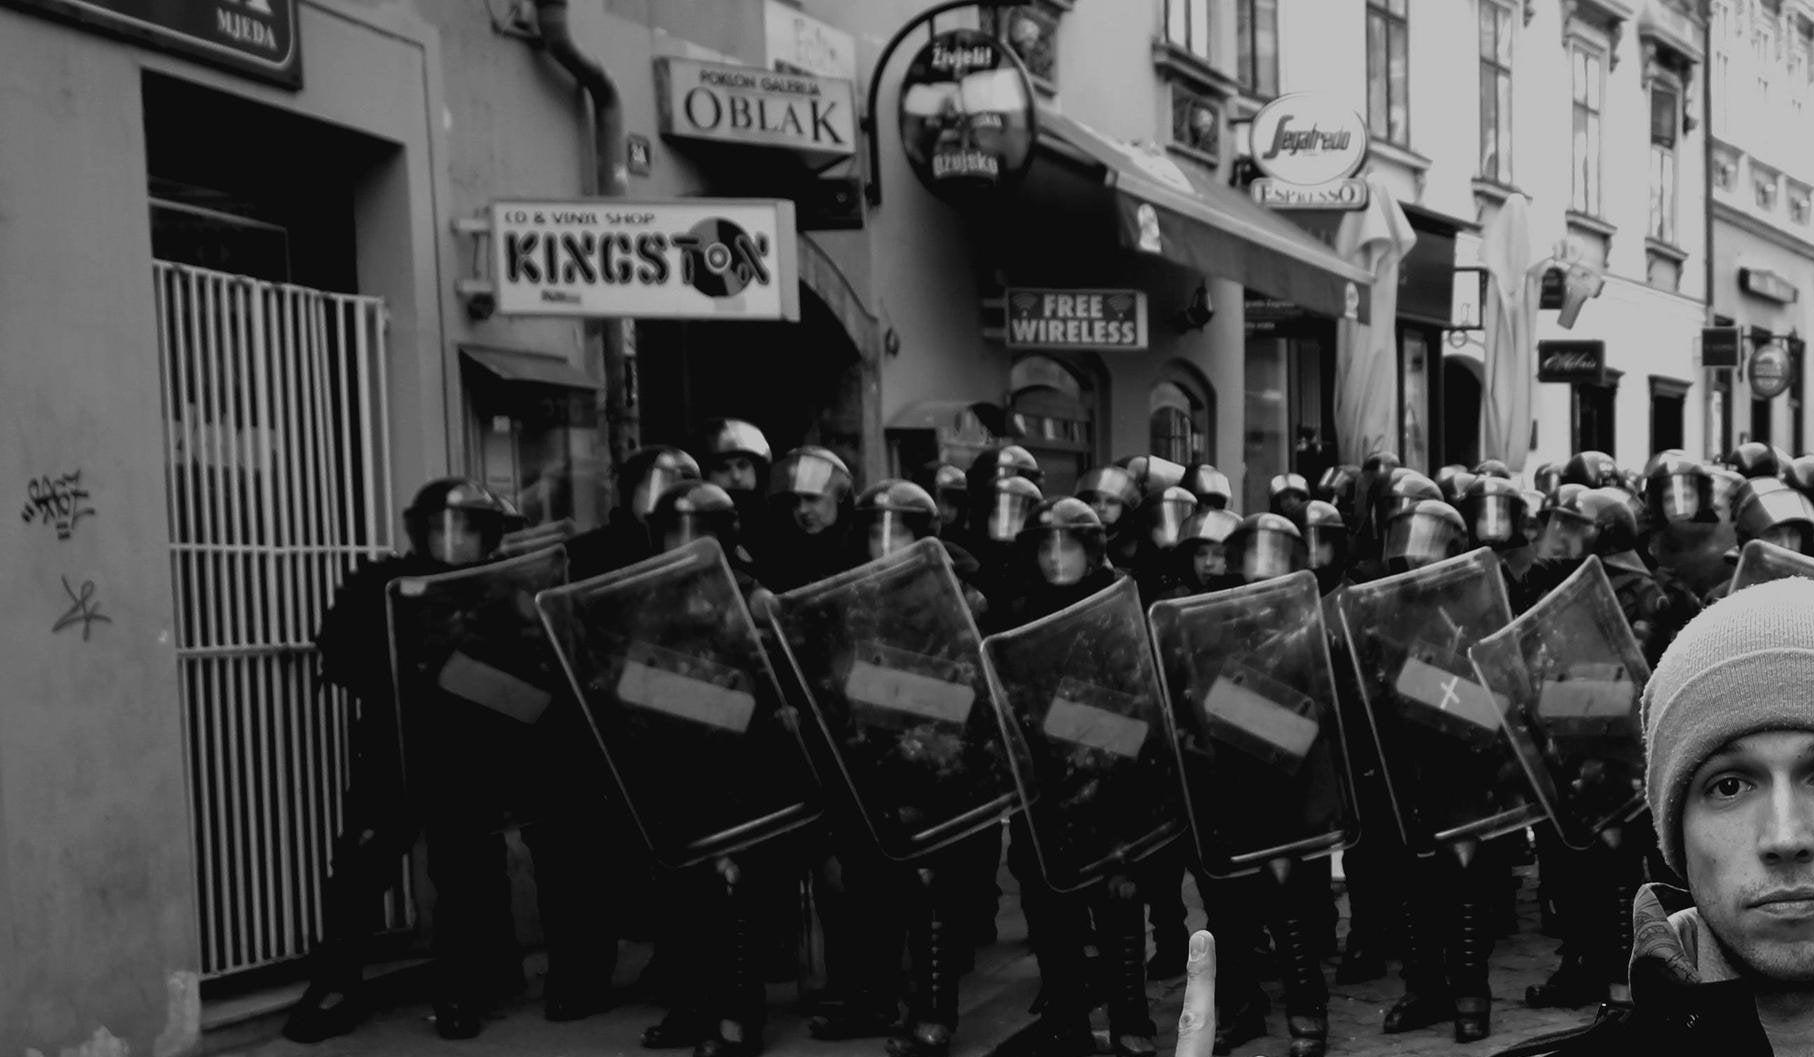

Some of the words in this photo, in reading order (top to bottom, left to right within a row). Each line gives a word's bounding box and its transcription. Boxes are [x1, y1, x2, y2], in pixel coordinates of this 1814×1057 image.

[684, 86, 844, 144] OBLAK
[1261, 184, 1356, 202] ESPRESSO
[533, 211, 546, 224] &
[605, 213, 656, 225] SHOP
[1043, 294, 1104, 318] FREE
[1011, 319, 1136, 343] WIRELESS
